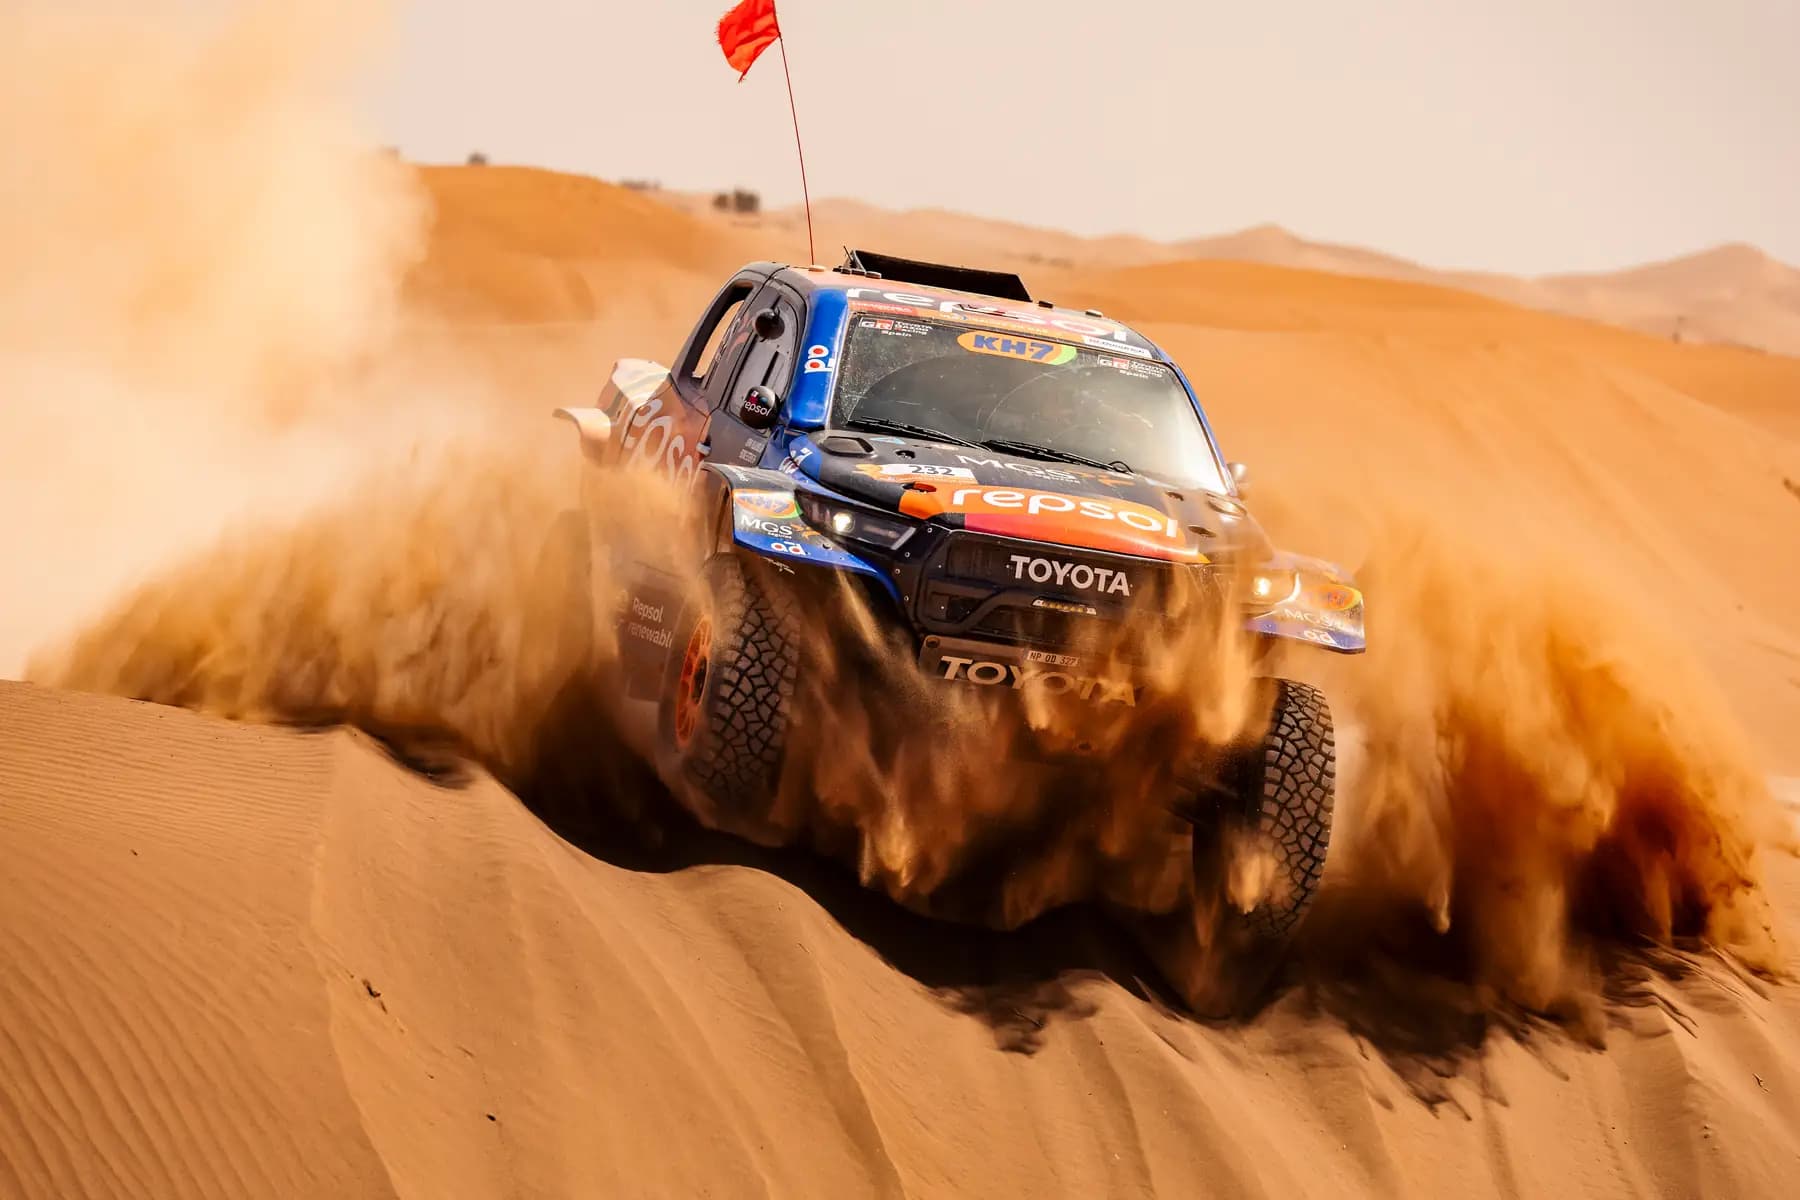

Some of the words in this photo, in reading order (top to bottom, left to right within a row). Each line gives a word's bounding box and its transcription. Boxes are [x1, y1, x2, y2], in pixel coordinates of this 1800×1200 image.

[973, 335, 1054, 360] KH-7
[908, 465, 956, 477] 232
[740, 514, 794, 536] MGS
[952, 489, 1179, 539] repsol
[1010, 554, 1131, 597] TOYOTA
[632, 597, 665, 624] Repsol
[940, 655, 1136, 707] TOYOTA
